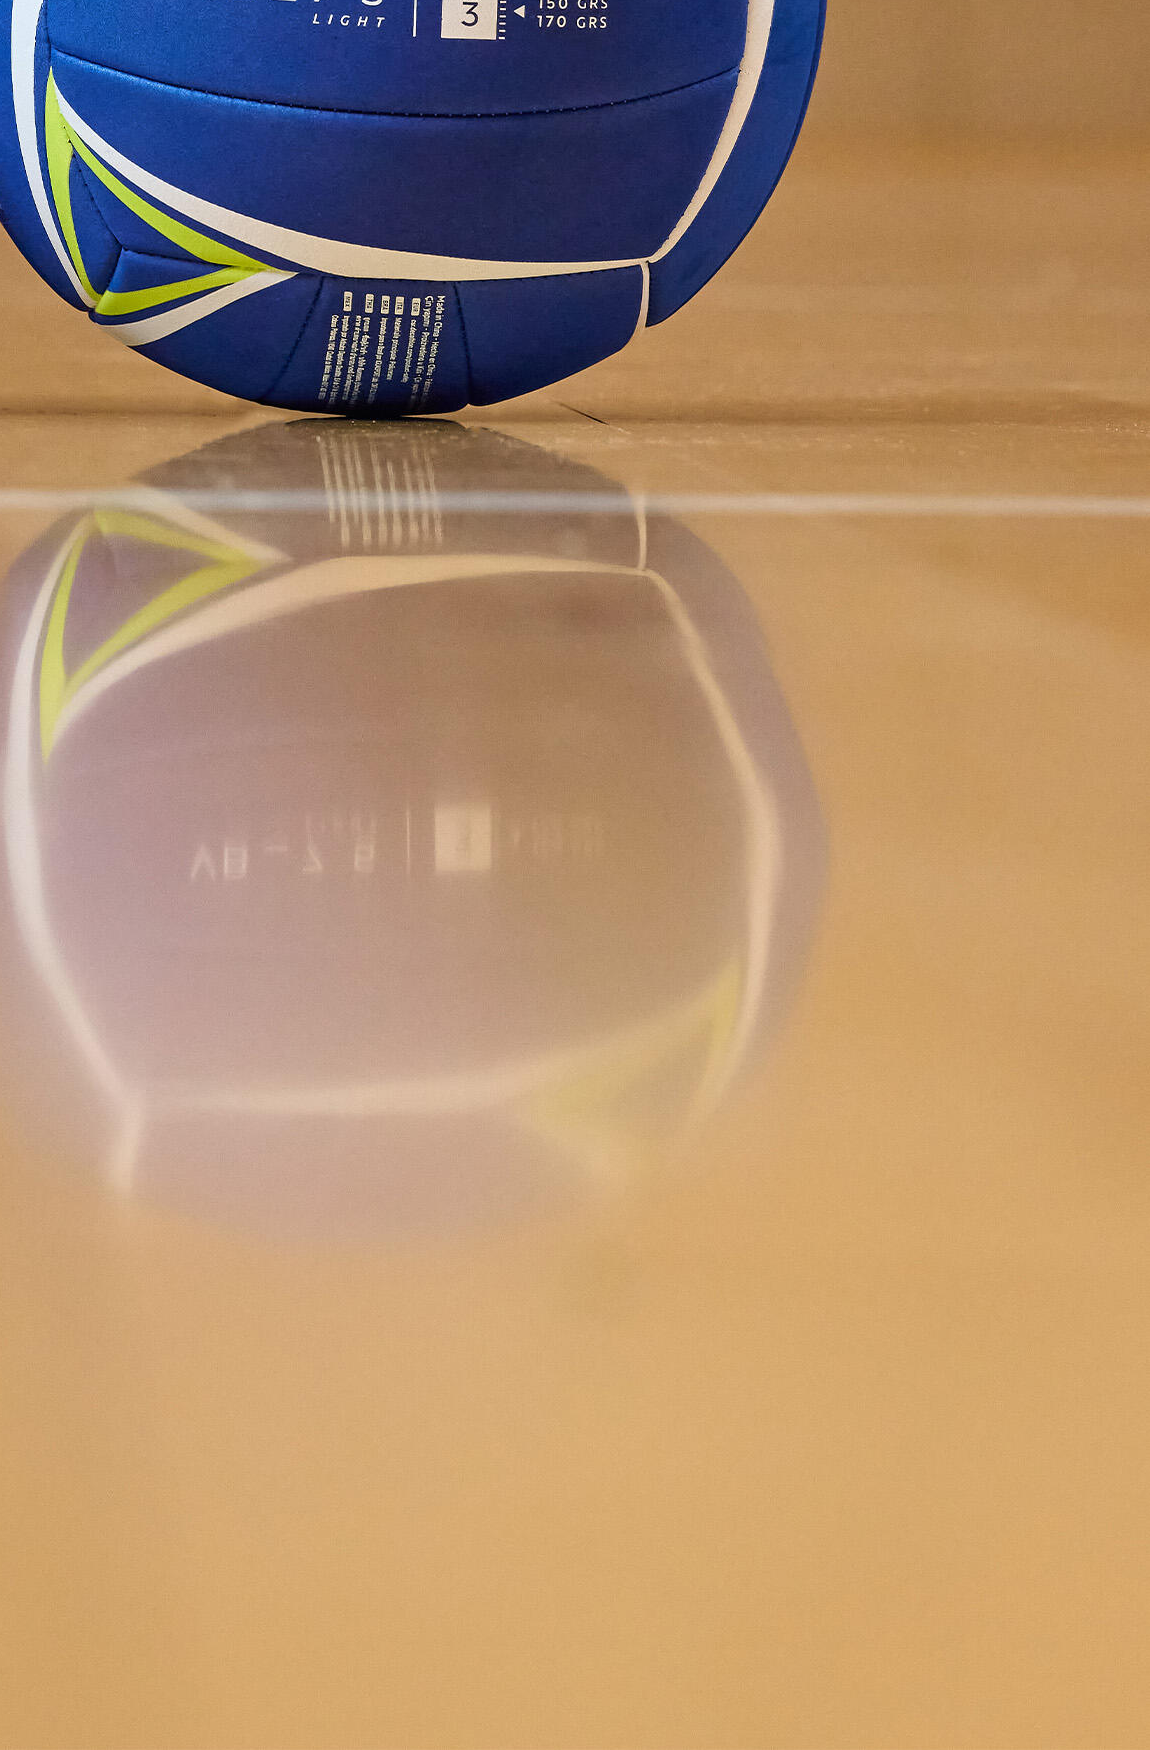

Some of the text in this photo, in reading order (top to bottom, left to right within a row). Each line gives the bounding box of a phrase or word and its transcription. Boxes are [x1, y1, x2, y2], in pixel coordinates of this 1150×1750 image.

[313, 13, 386, 28] LIGHT
[461, 1, 480, 27] 3
[536, 14, 607, 29] 170 GRS
[435, 295, 446, 314] Made
[432, 321, 443, 337] China
